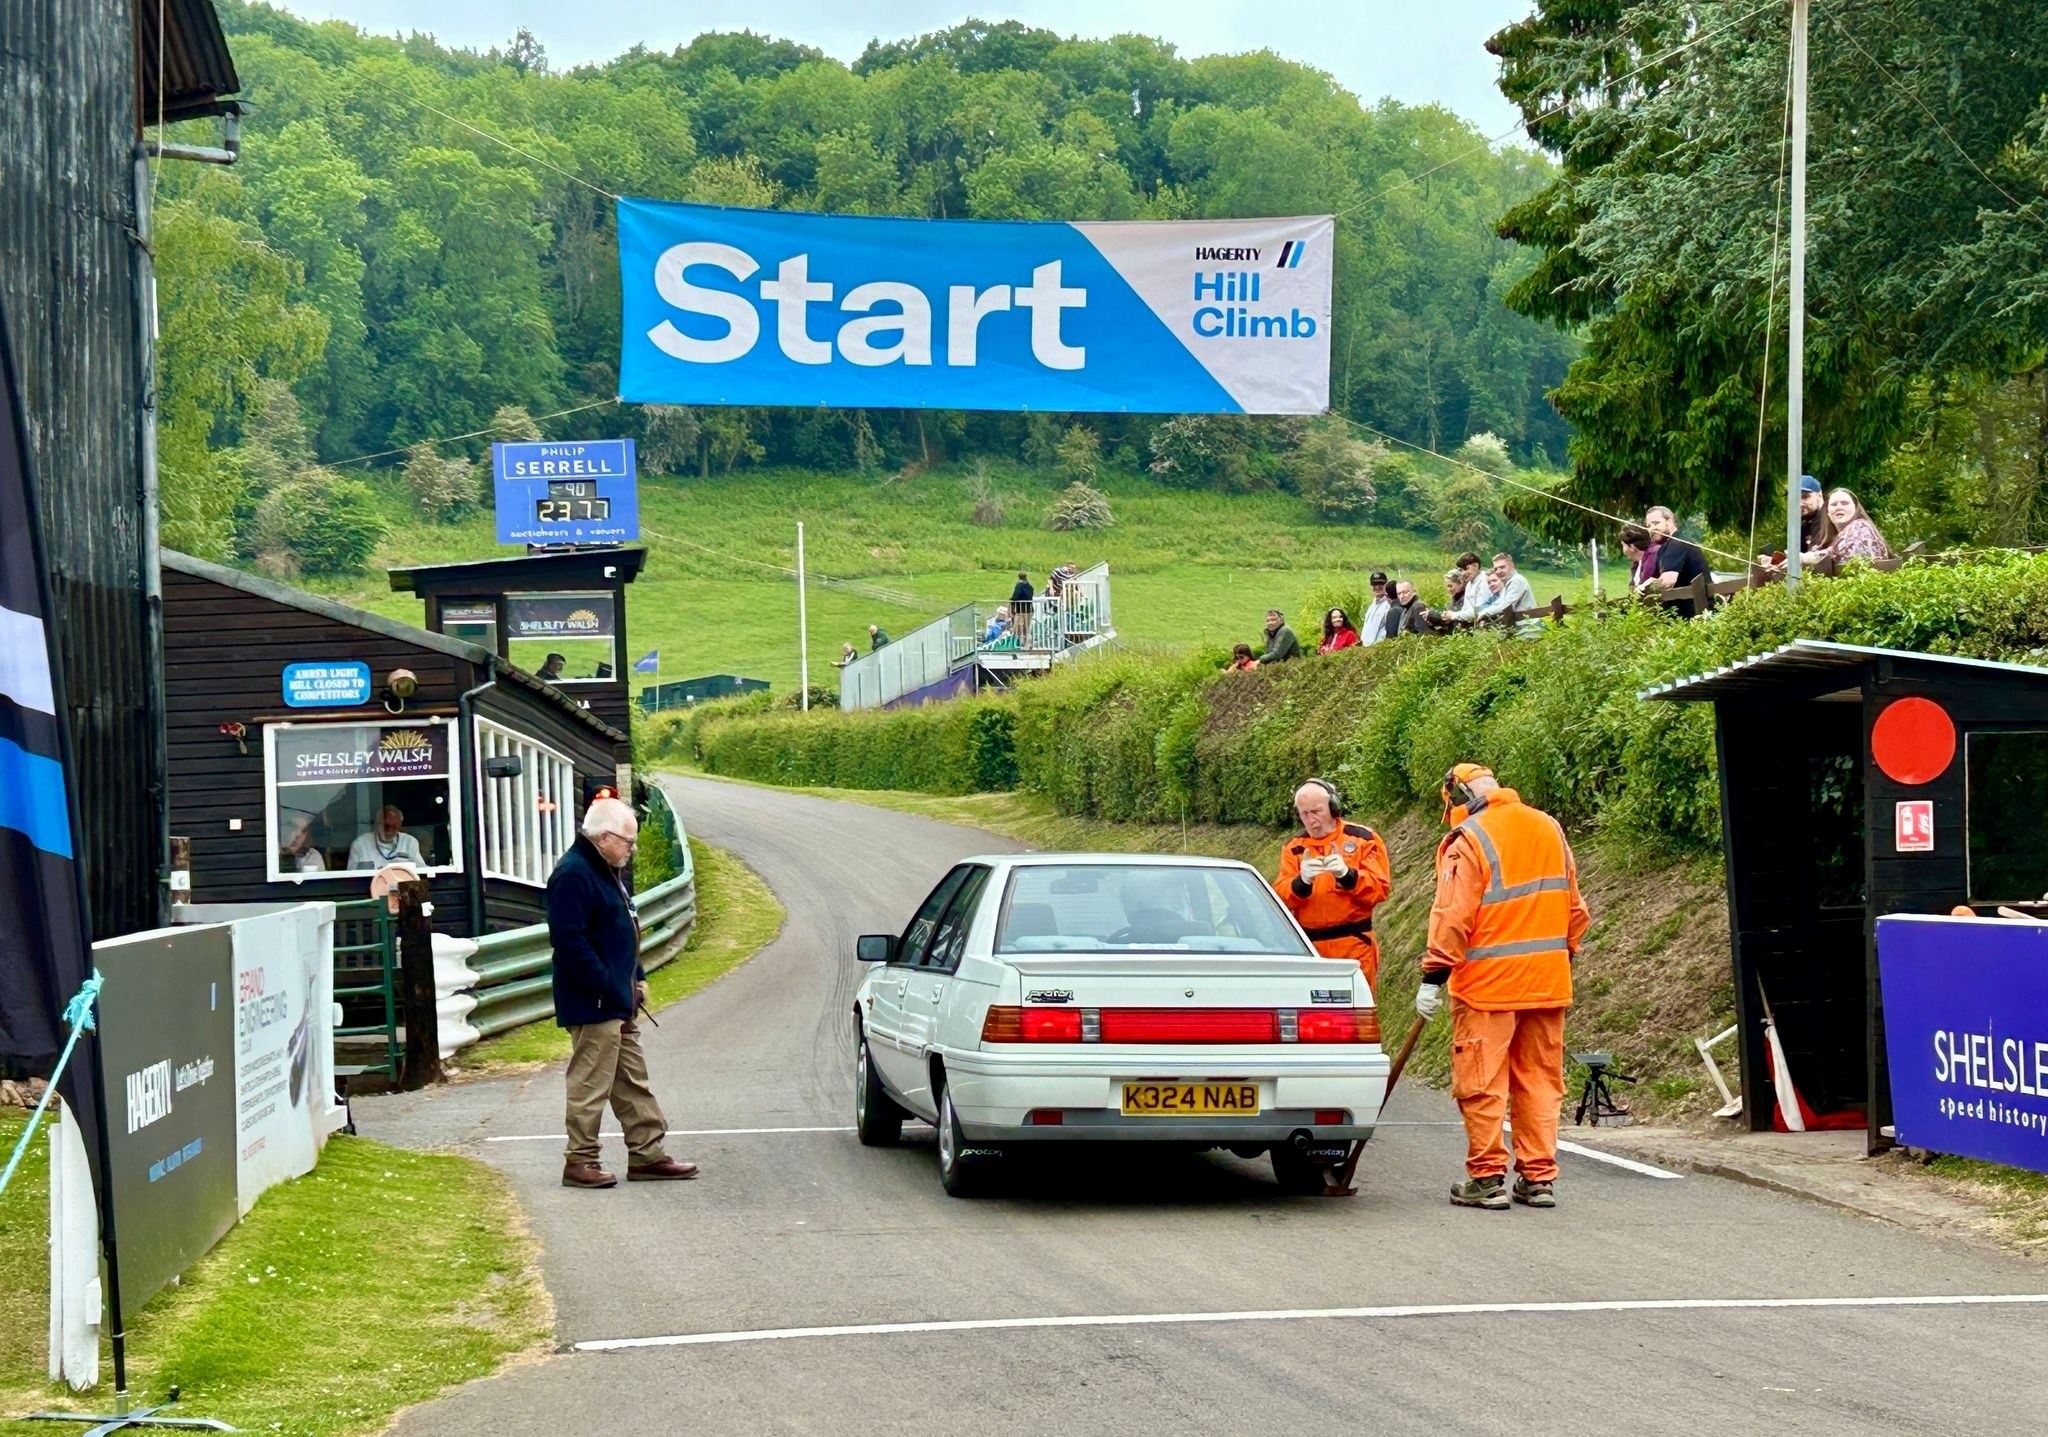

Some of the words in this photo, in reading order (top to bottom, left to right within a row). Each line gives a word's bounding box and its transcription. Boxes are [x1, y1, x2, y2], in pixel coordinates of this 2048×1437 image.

[1195, 247, 1261, 261] HAGERTY
[1194, 272, 1260, 302] Hill
[646, 242, 1087, 370] Start
[1193, 307, 1316, 338] Climb
[541, 447, 585, 456] PHILIP
[515, 459, 611, 475] SERRELL
[519, 620, 566, 631] SHELSLEY
[566, 618, 599, 629] WALSH
[294, 669, 328, 679] AMBER
[329, 668, 359, 678] LIGHT
[313, 679, 350, 689] CLOSED
[351, 678, 365, 689] TO
[294, 690, 360, 701] COMPETITORS
[296, 751, 374, 768] SHELSLEY
[379, 748, 432, 764] WALSH
[126, 1058, 172, 1134] HAGERTY
[1125, 1086, 1197, 1109] K324
[1203, 1086, 1256, 1109] NAB
[1940, 1097, 1983, 1121] speed
[1989, 1099, 2047, 1136] history
